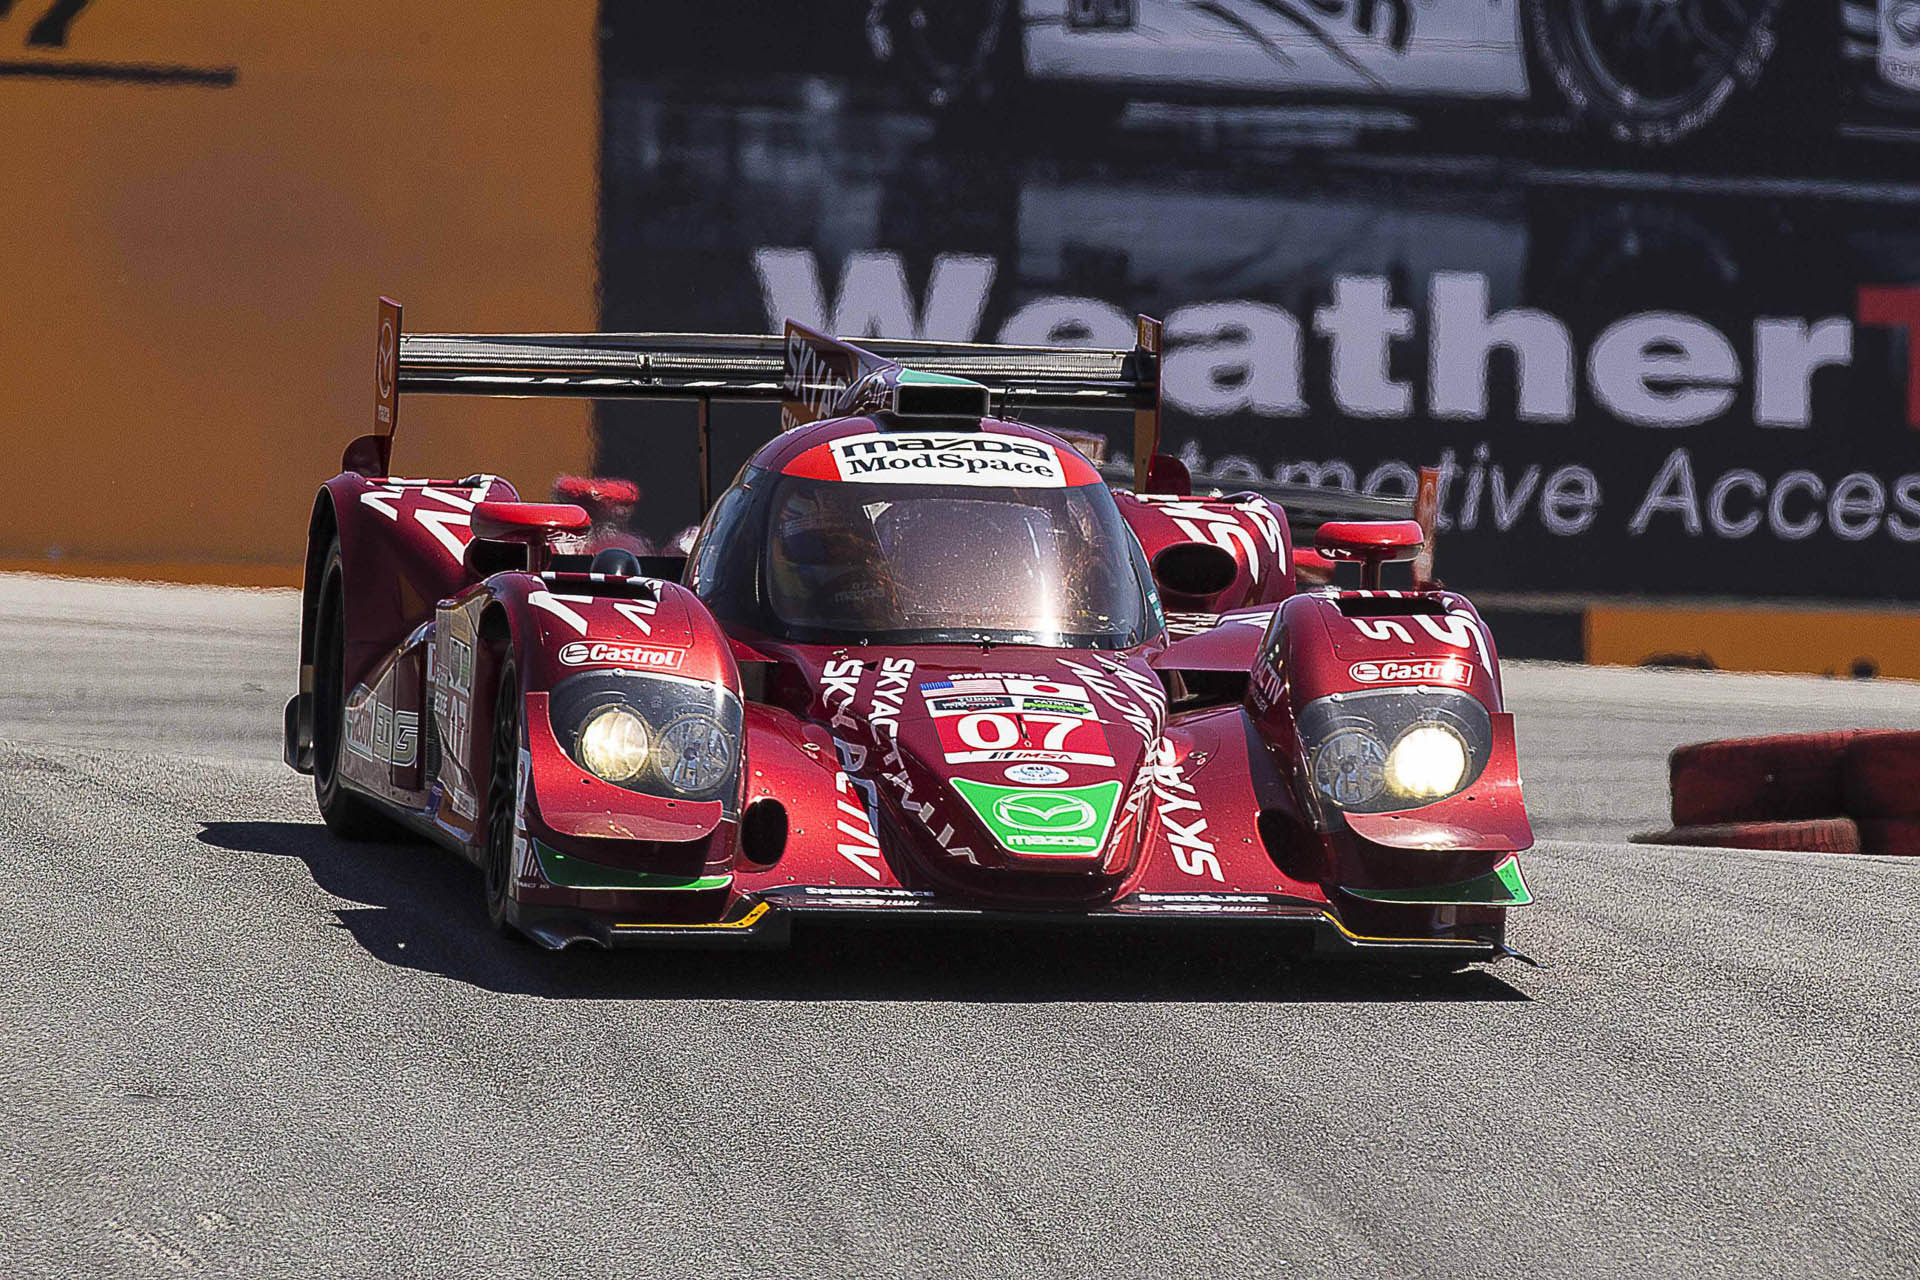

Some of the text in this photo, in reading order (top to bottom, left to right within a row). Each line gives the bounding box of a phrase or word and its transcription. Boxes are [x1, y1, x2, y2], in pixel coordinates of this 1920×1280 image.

[840, 437, 1051, 461] mazda
[849, 453, 1055, 478] ModSpace
[589, 643, 677, 667] Castrol
[957, 713, 1084, 750] 07
[1016, 752, 1073, 760] IMSA
[1007, 834, 1097, 848] mazda
